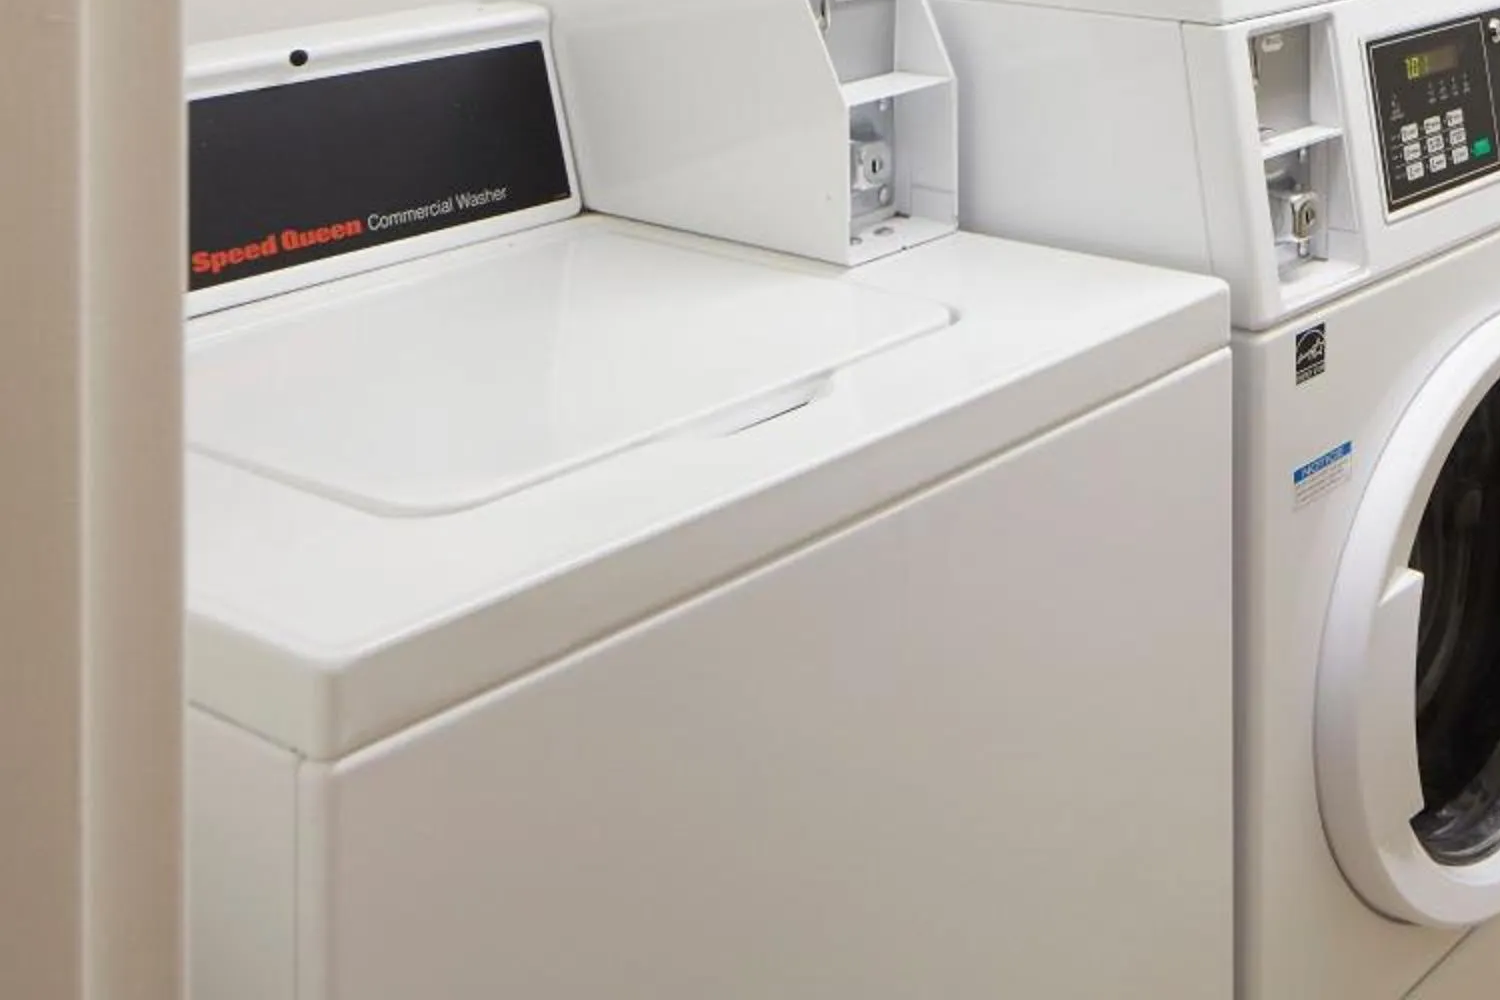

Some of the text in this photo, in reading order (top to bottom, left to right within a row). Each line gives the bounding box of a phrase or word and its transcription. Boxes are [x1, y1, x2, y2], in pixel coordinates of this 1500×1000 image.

[191, 185, 509, 274] Speed Queen Commercial Washer
